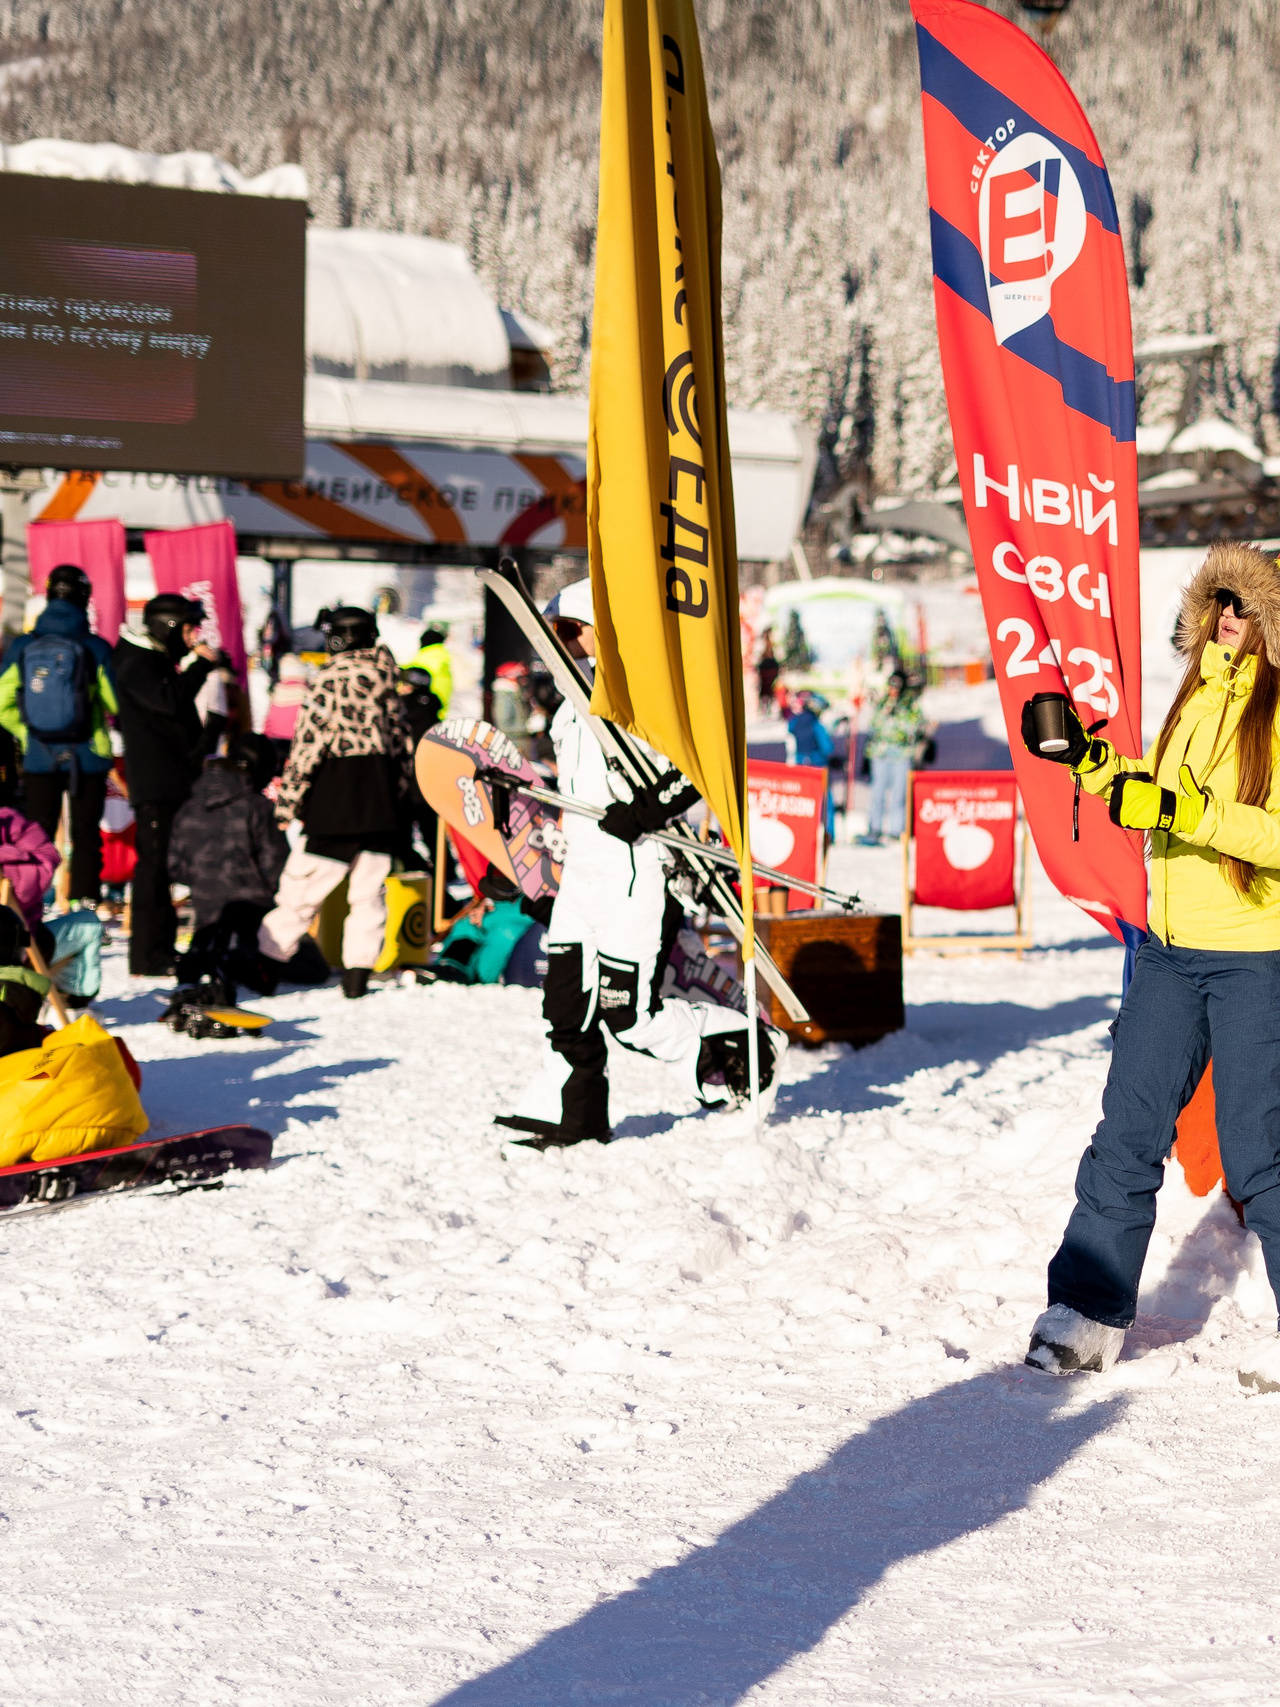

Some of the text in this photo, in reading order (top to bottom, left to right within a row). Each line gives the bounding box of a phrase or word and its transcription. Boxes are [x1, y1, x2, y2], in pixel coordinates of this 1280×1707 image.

[969, 118, 1016, 194] СЕКТОР
[1003, 293, 1044, 303] ШЕРЕГЕШ
[281, 476, 478, 511] СИБИРСКОЕ
